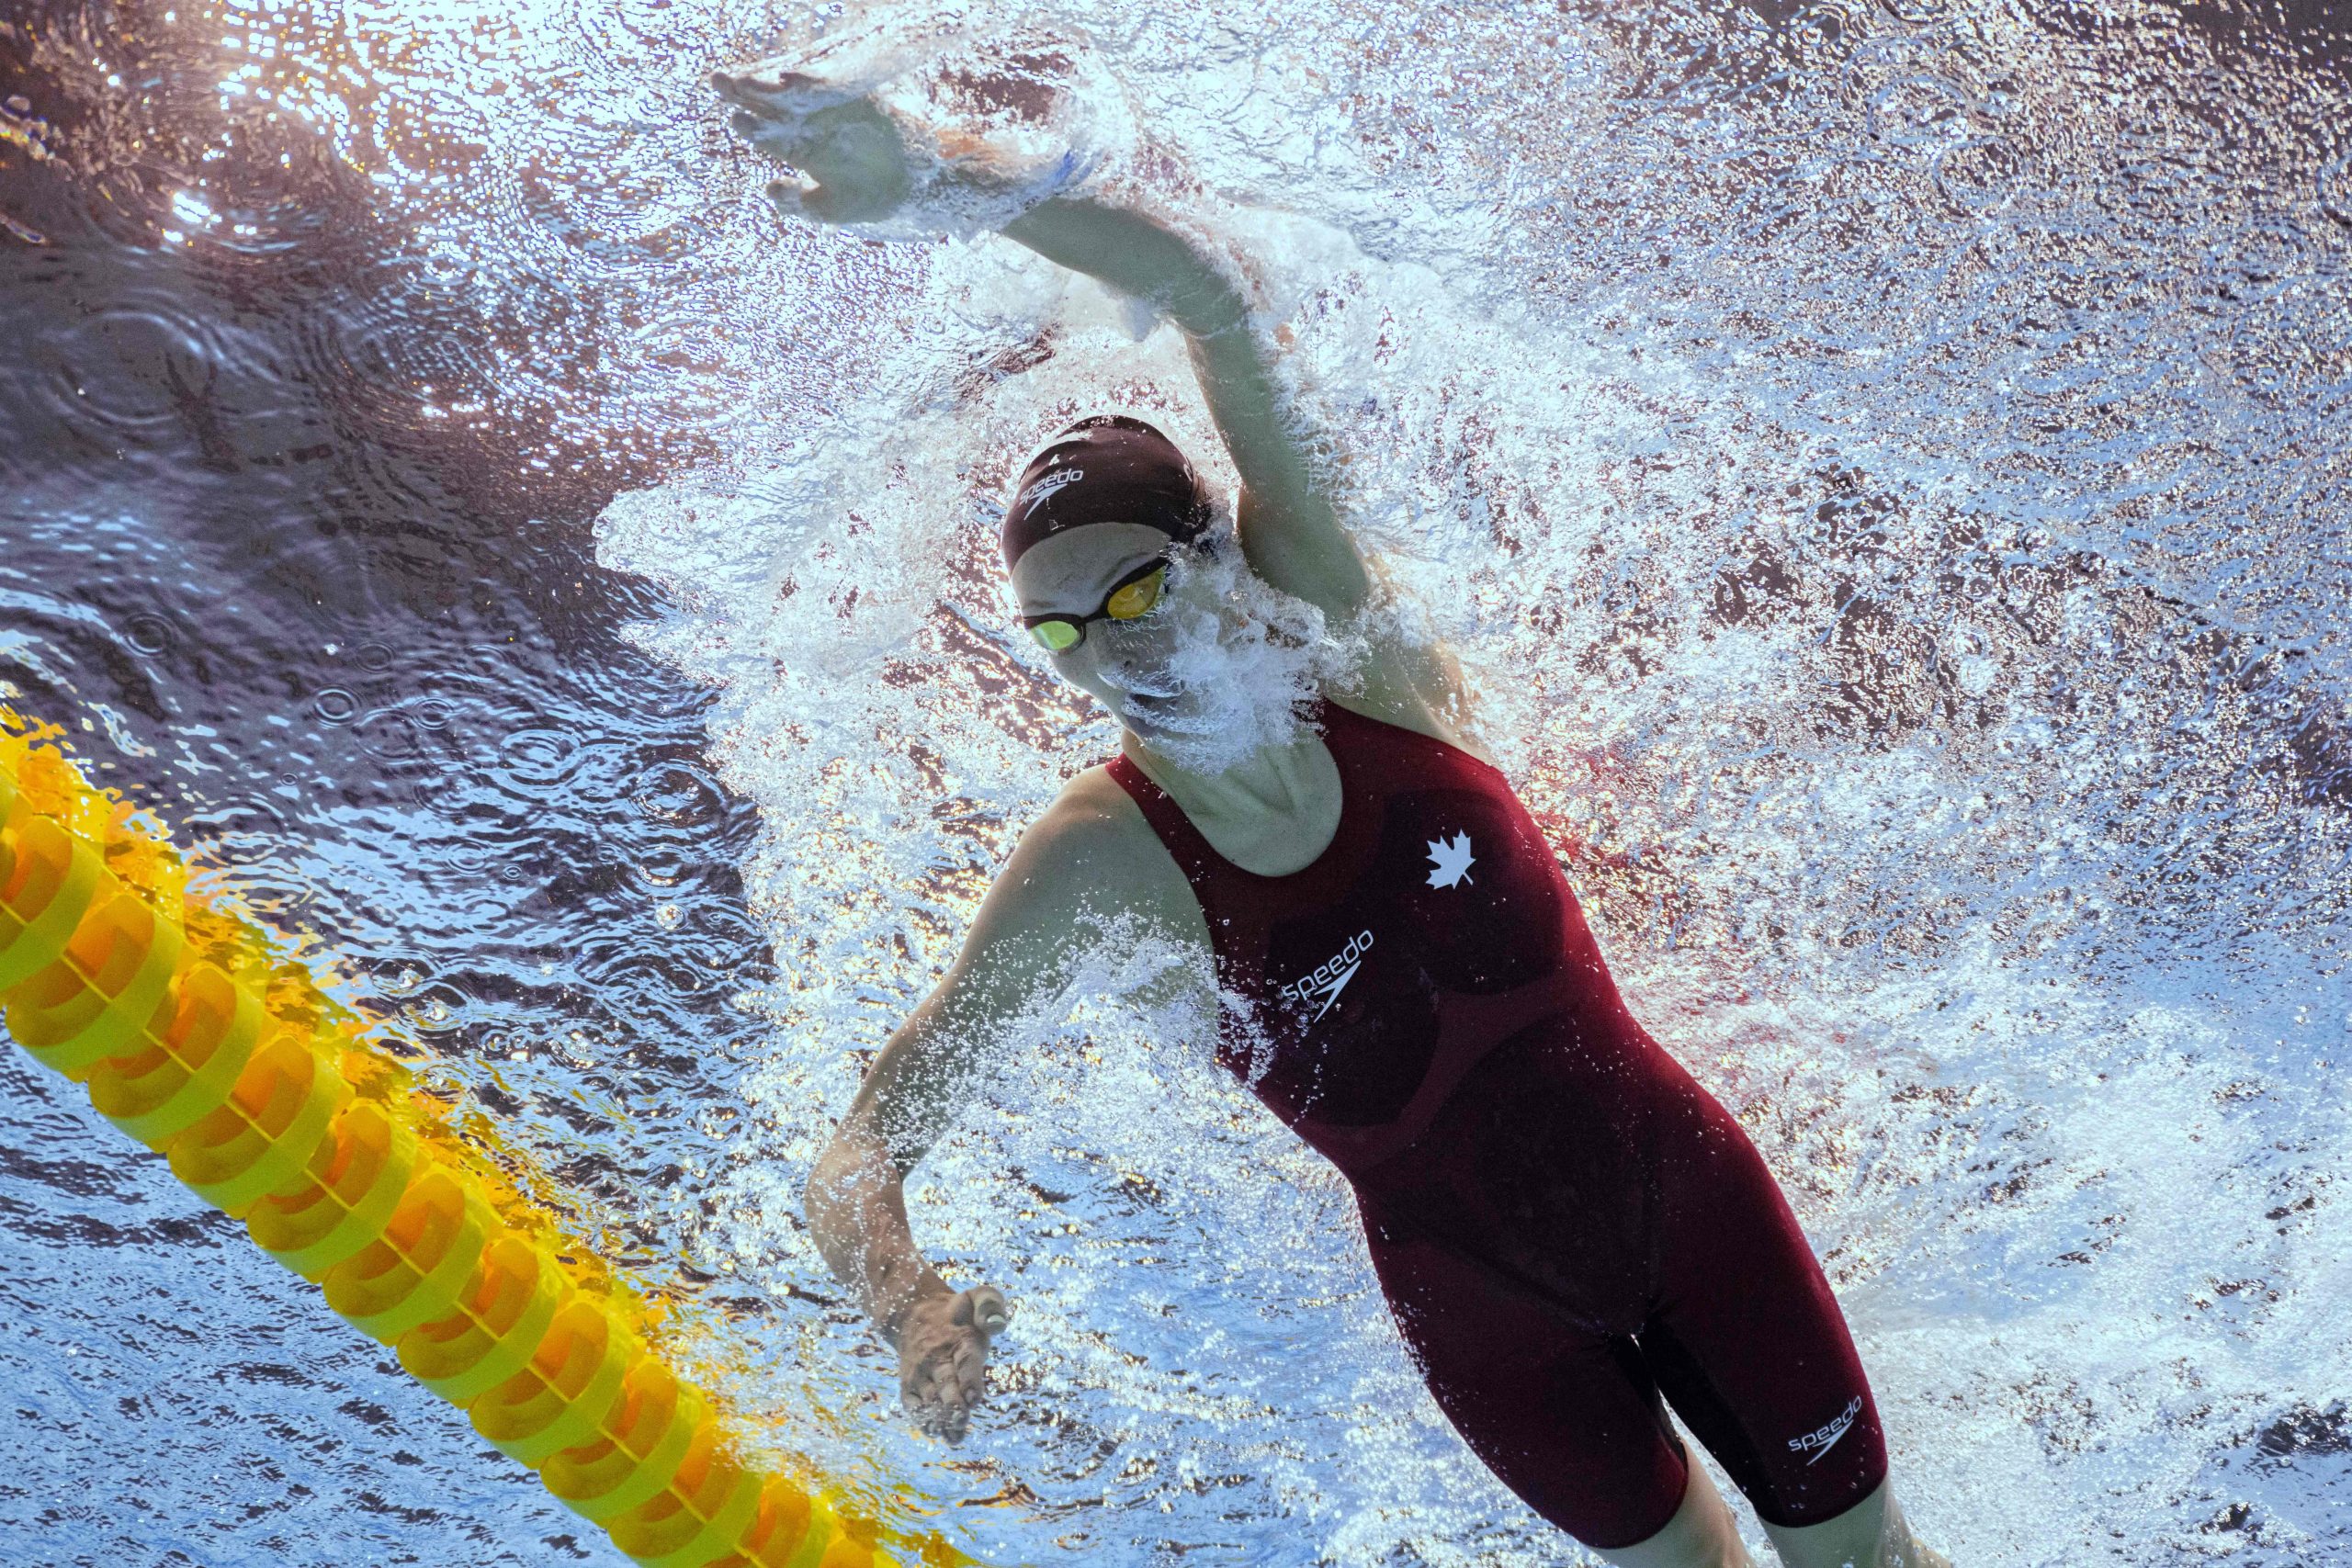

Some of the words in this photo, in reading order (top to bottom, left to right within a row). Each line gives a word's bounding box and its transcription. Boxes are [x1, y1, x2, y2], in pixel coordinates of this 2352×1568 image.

[1019, 468, 1084, 507] speedo
[1283, 930, 1374, 1001] speedo
[1788, 1395, 1862, 1451] speedo
